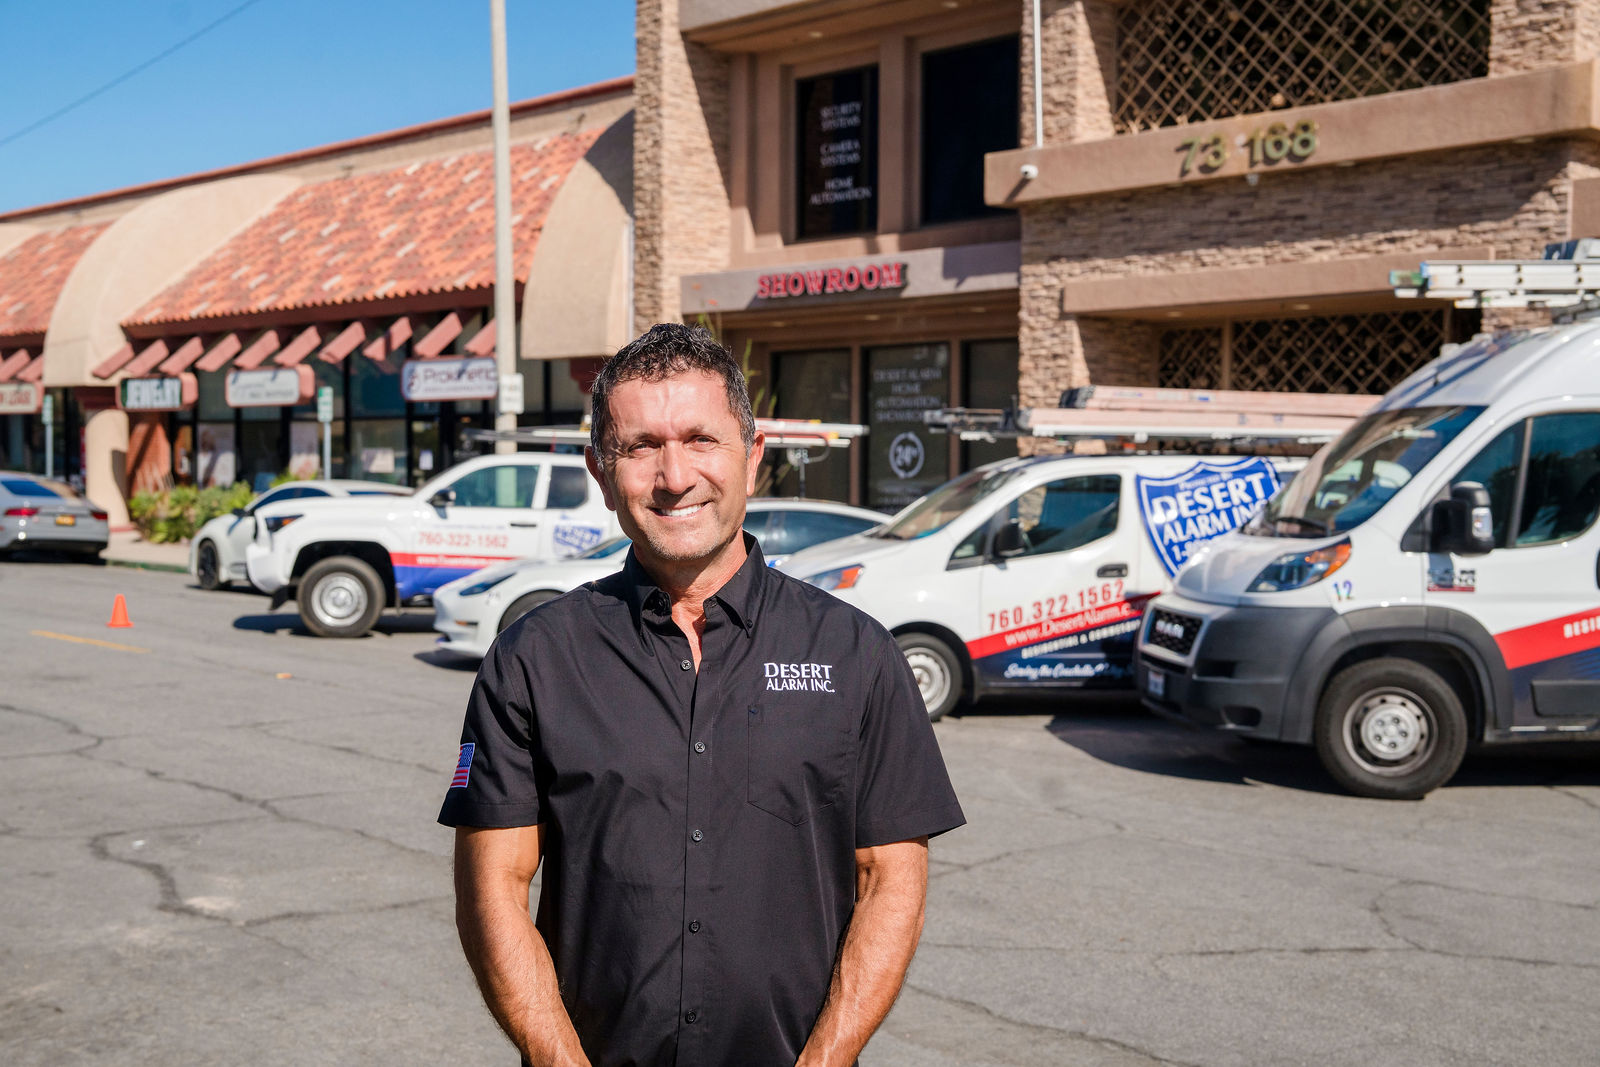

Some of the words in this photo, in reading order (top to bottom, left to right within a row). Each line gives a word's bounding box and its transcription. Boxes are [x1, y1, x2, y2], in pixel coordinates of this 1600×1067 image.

[820, 139, 861, 155] CAMERA
[1178, 131, 1227, 174] 73
[1248, 119, 1317, 165] 168
[809, 186, 873, 205] AUTOMATION
[757, 262, 905, 299] SHOWROOM
[1151, 471, 1266, 524] DESERT
[1163, 509, 1232, 546] ALARM
[418, 531, 509, 548] 760-322-1562
[1333, 580, 1353, 601] 12
[988, 578, 1125, 632] 760.322.1562
[763, 662, 833, 679] DESERT
[766, 678, 809, 691] ALARM
[810, 678, 836, 693] INC.
